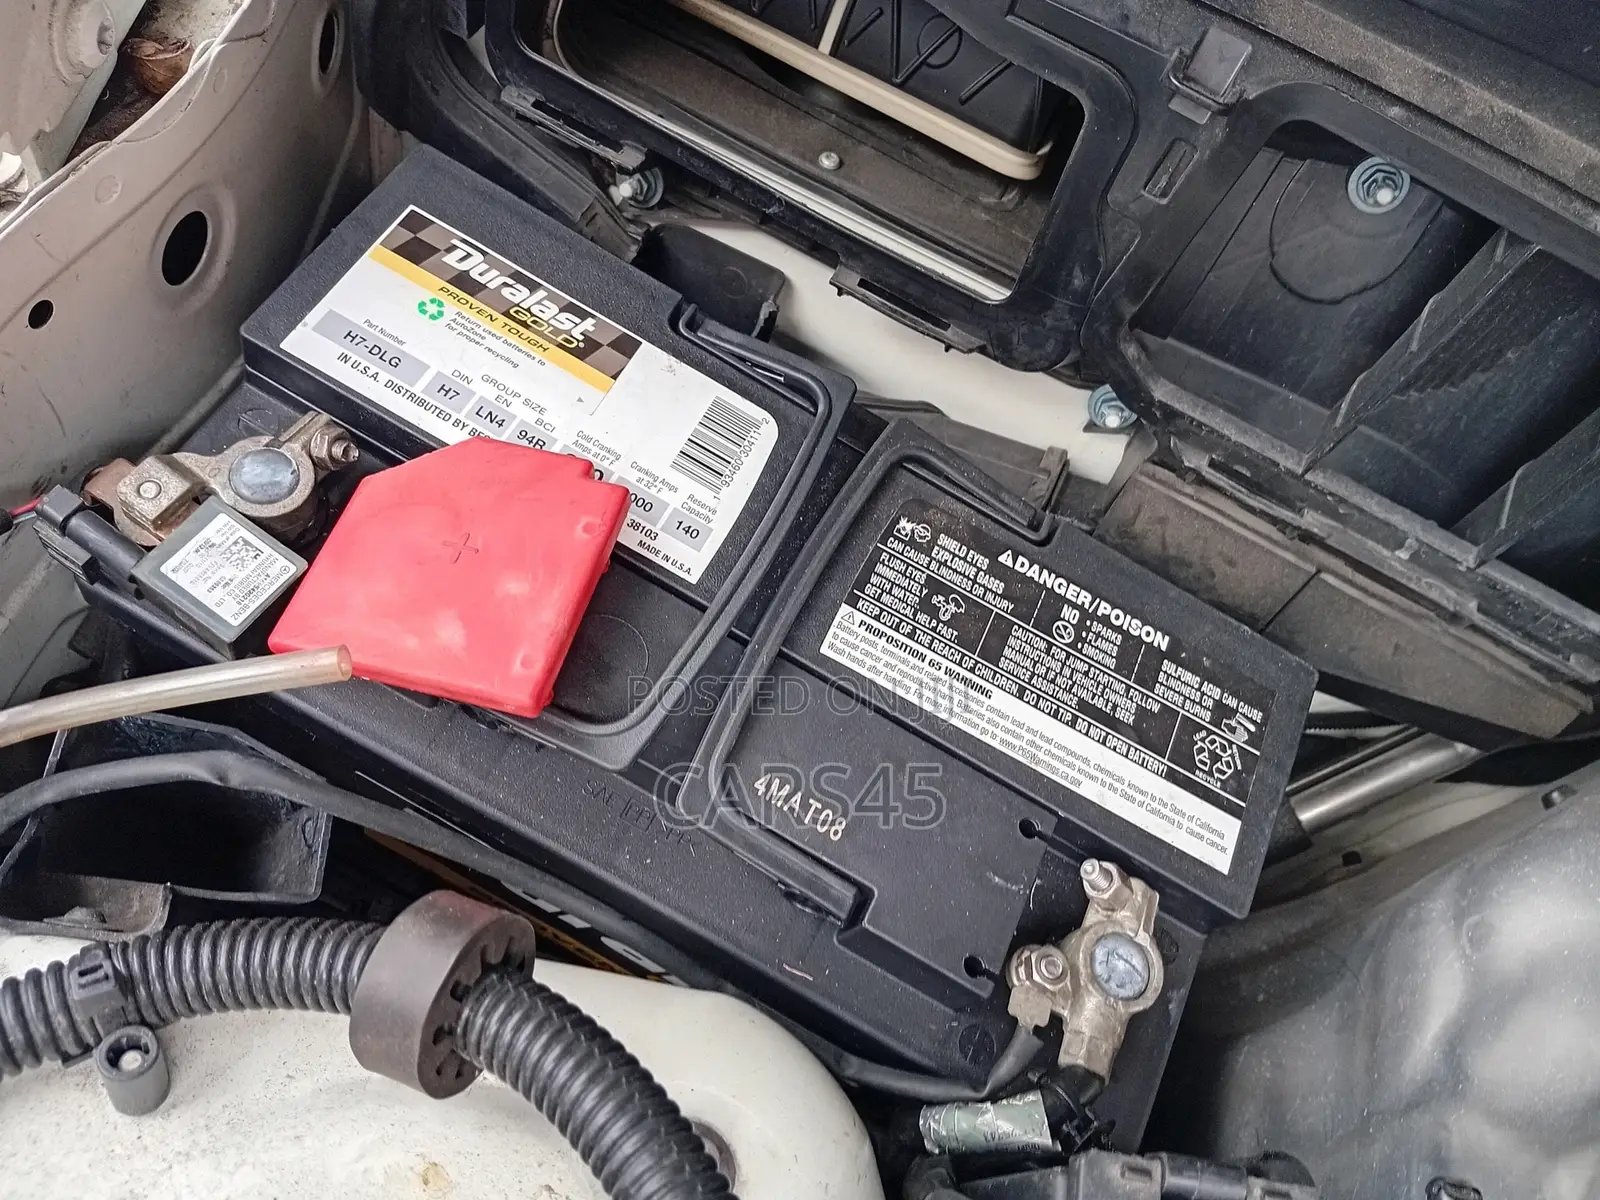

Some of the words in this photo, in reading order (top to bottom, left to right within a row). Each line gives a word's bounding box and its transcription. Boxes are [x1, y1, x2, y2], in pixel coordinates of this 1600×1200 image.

[441, 238, 597, 342] Duralast
[362, 318, 378, 331] Part
[377, 327, 406, 346] Number
[437, 286, 498, 322] PROVEN
[501, 321, 549, 352] TOUGH
[449, 317, 486, 340] AutoZone
[454, 311, 481, 329] Return
[482, 327, 503, 340] used
[501, 338, 536, 360] batteries
[505, 307, 580, 350] GOLD
[343, 330, 401, 368] H7-DLG
[444, 322, 457, 331] for
[455, 330, 484, 346] proper
[483, 346, 519, 368] recycling
[336, 352, 351, 364] IN
[350, 359, 379, 382] U.S.A.
[383, 379, 451, 421] DISTRIBUTED
[451, 417, 469, 431] BY
[436, 383, 460, 400] H7
[451, 369, 473, 385] DIN
[481, 374, 521, 398] GROUP
[522, 398, 547, 415] SIZE
[475, 405, 505, 428] LN4
[494, 394, 512, 407] EN
[514, 428, 547, 451] 94R
[534, 417, 555, 433] BCI
[571, 439, 592, 454] Amps
[591, 451, 600, 459] at
[576, 430, 593, 443] Cold
[592, 439, 621, 461] Cranking
[719, 456, 746, 488] 93460
[737, 428, 763, 458] 30411
[630, 460, 659, 483] Cranking
[658, 478, 678, 493] Amps
[635, 476, 644, 484] at
[680, 501, 713, 524] Capacity
[686, 493, 717, 515] Reserve
[626, 518, 658, 541] 38103
[676, 520, 699, 539] 140
[248, 551, 274, 575] HYUNDAI
[636, 539, 661, 557] MADE
[660, 553, 671, 562] IN
[670, 558, 691, 576] U.S.A.
[879, 551, 906, 573] FLUSH
[905, 565, 926, 584] EYES
[931, 545, 977, 579] EXPLOSIVE
[976, 570, 1004, 594] GASES
[937, 533, 967, 557] SHIELD
[966, 549, 989, 570] EYES
[237, 555, 279, 595] MANUFACTURED
[869, 572, 891, 592] WITH
[874, 562, 928, 597] IMMEDIATELY
[886, 536, 904, 553] CAN
[903, 545, 930, 567] CAUSE
[929, 559, 972, 591] BLINDNESS
[971, 583, 984, 598] OR
[984, 590, 1014, 613] INJURY
[229, 570, 283, 621] MERCEDES-BENZ
[230, 592, 241, 601] BY
[864, 583, 881, 599] GET
[879, 591, 914, 619] MEDICAL
[915, 610, 937, 629] HELP
[936, 622, 958, 643] FAST.
[1013, 555, 1169, 651] DANGER/POISON
[1060, 603, 1079, 624] NO
[1086, 631, 1118, 656] FLAMES
[1091, 620, 1122, 645] SPARKS
[827, 640, 846, 657] Wash
[845, 651, 867, 668] hands
[866, 664, 883, 677] after
[857, 619, 927, 663] PROPOSITION
[927, 658, 942, 671] 65
[944, 665, 992, 699] WARNING
[1006, 635, 1061, 673] INSTRUCTIONS
[1061, 664, 1071, 678] IN
[1072, 670, 1103, 695] VEHICLE
[1103, 687, 1136, 713] OWNERS
[1011, 624, 1047, 652] CAUTION:
[1049, 645, 1066, 662] FOR
[1065, 655, 1088, 673] JUMP
[1127, 688, 1160, 713] FOLLOW
[1082, 643, 1116, 669] SMOKING
[856, 597, 880, 617] KEEP
[879, 611, 899, 628] OUT
[898, 621, 912, 635] OF
[914, 628, 932, 647] THE
[930, 638, 961, 663] REACH
[961, 655, 975, 669] OF
[974, 663, 1018, 697] CHILDREN.
[1022, 689, 1037, 705] DO
[1037, 697, 1057, 715] NOT
[1057, 707, 1072, 725] TIP.
[1075, 717, 1088, 733] DO
[1087, 724, 1106, 742] NOT
[1105, 734, 1128, 755] OPEN
[1127, 746, 1167, 777] BATTERY!
[998, 656, 1031, 682] SERVICE
[1030, 674, 1078, 709] ASSISTANCE.
[1002, 645, 1034, 672] MANUAL
[1034, 662, 1046, 677] OR
[1046, 669, 1055, 681] IF
[1054, 673, 1072, 690] NOT
[1071, 683, 1113, 716] AVAILABLE,
[1114, 706, 1135, 726] SEEK
[1157, 671, 1200, 702] BLINDNESS
[1201, 695, 1213, 709] OR
[1161, 659, 1200, 688] SULFURIC
[1200, 680, 1221, 700] ACID
[1221, 692, 1237, 709] CAN
[1238, 701, 1262, 723] CAUSE
[1153, 682, 1184, 707] SEVERE
[1183, 699, 1211, 722] BURNS
[835, 620, 860, 640] Battery
[858, 635, 878, 651] posts,
[880, 645, 910, 667] terminals
[985, 704, 1010, 722] contain
[1009, 716, 1025, 730] lead
[1038, 731, 1054, 745] lead
[1053, 741, 1091, 768] compounds,
[1092, 763, 1125, 785] chemicals
[1126, 779, 1149, 798] known
[1168, 802, 1186, 819] State
[1194, 817, 1224, 840] California
[839, 636, 859, 651] cause
[859, 647, 883, 663] cancer
[985, 716, 1000, 729] also
[999, 724, 1024, 742] contain
[1025, 738, 1043, 752] other
[1043, 748, 1076, 771] chemicals
[1076, 765, 1099, 783] known
[1118, 788, 1136, 804] State
[1145, 802, 1175, 826] California
[1185, 826, 1204, 842] cause
[1205, 837, 1228, 855] cancer.
[1194, 769, 1221, 788] RECYCLE
